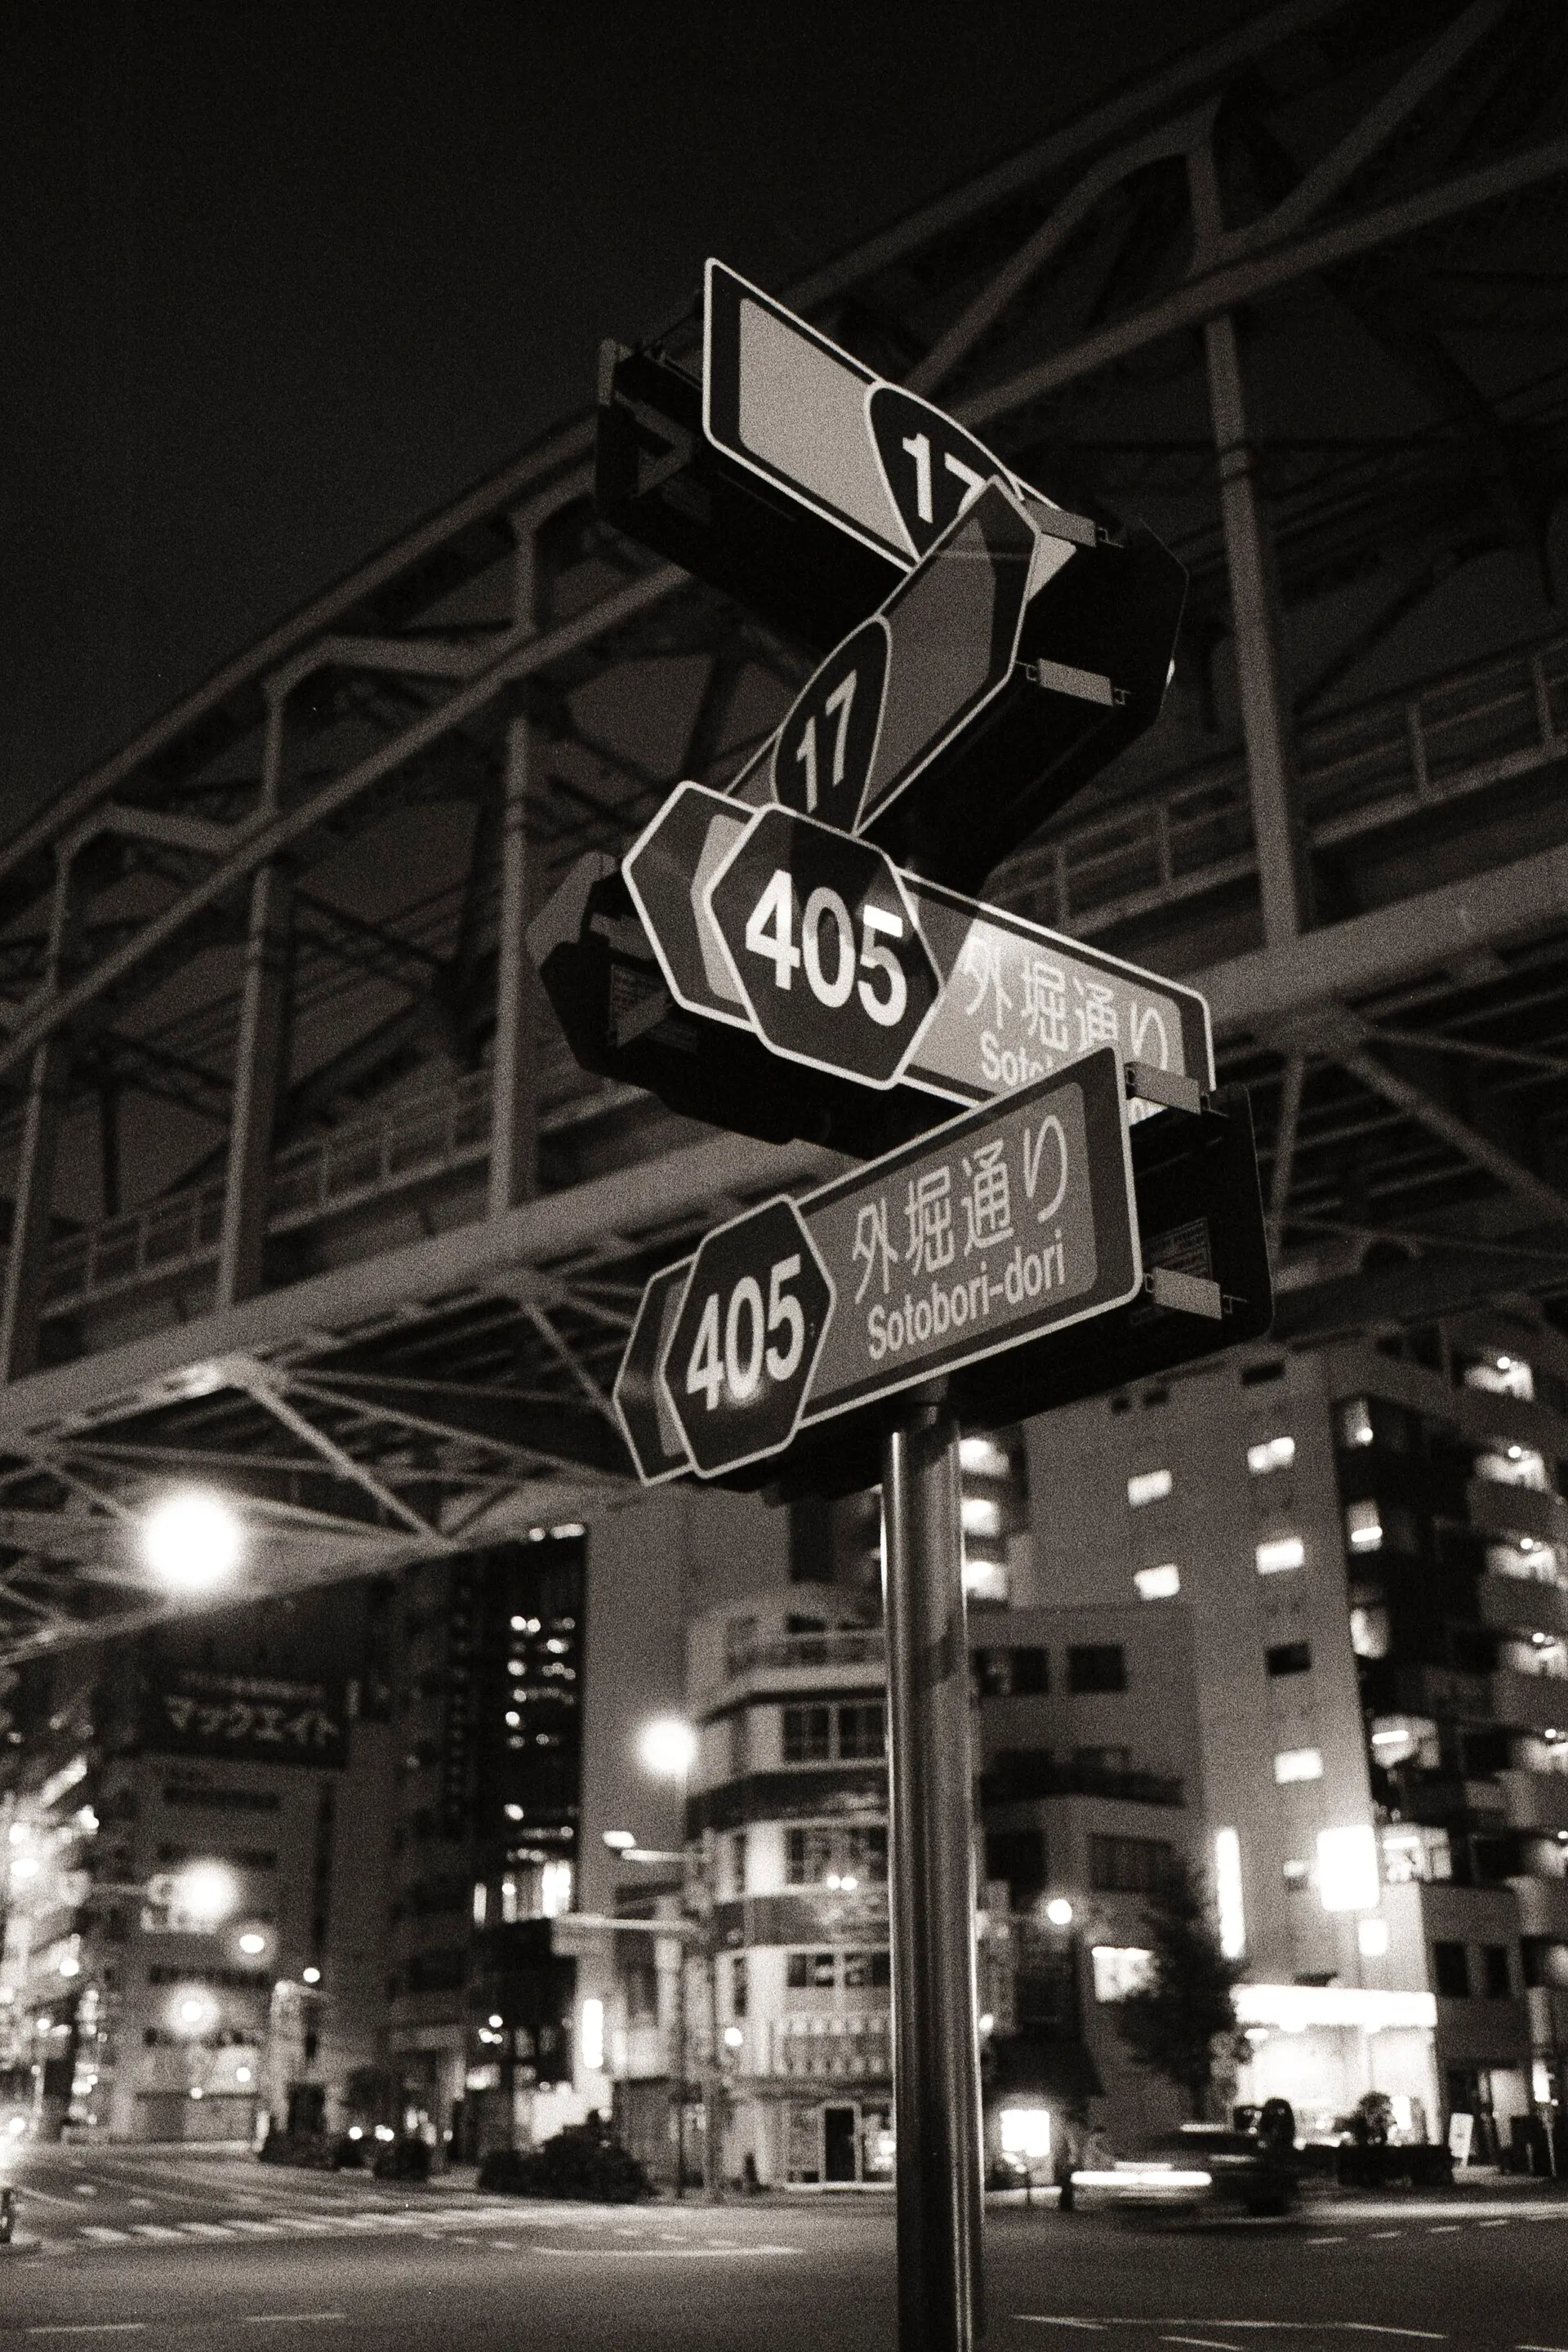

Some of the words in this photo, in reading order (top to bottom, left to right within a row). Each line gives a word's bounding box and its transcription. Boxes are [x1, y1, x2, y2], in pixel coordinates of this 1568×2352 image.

[902, 433, 987, 523] 17
[796, 669, 858, 814] 17
[745, 868, 908, 1027] 405
[964, 935, 1169, 1071] 外堀通り
[852, 1115, 1068, 1305] 外堀通り
[686, 1253, 804, 1411] 405
[866, 1228, 1065, 1361] Sotobori-dori
